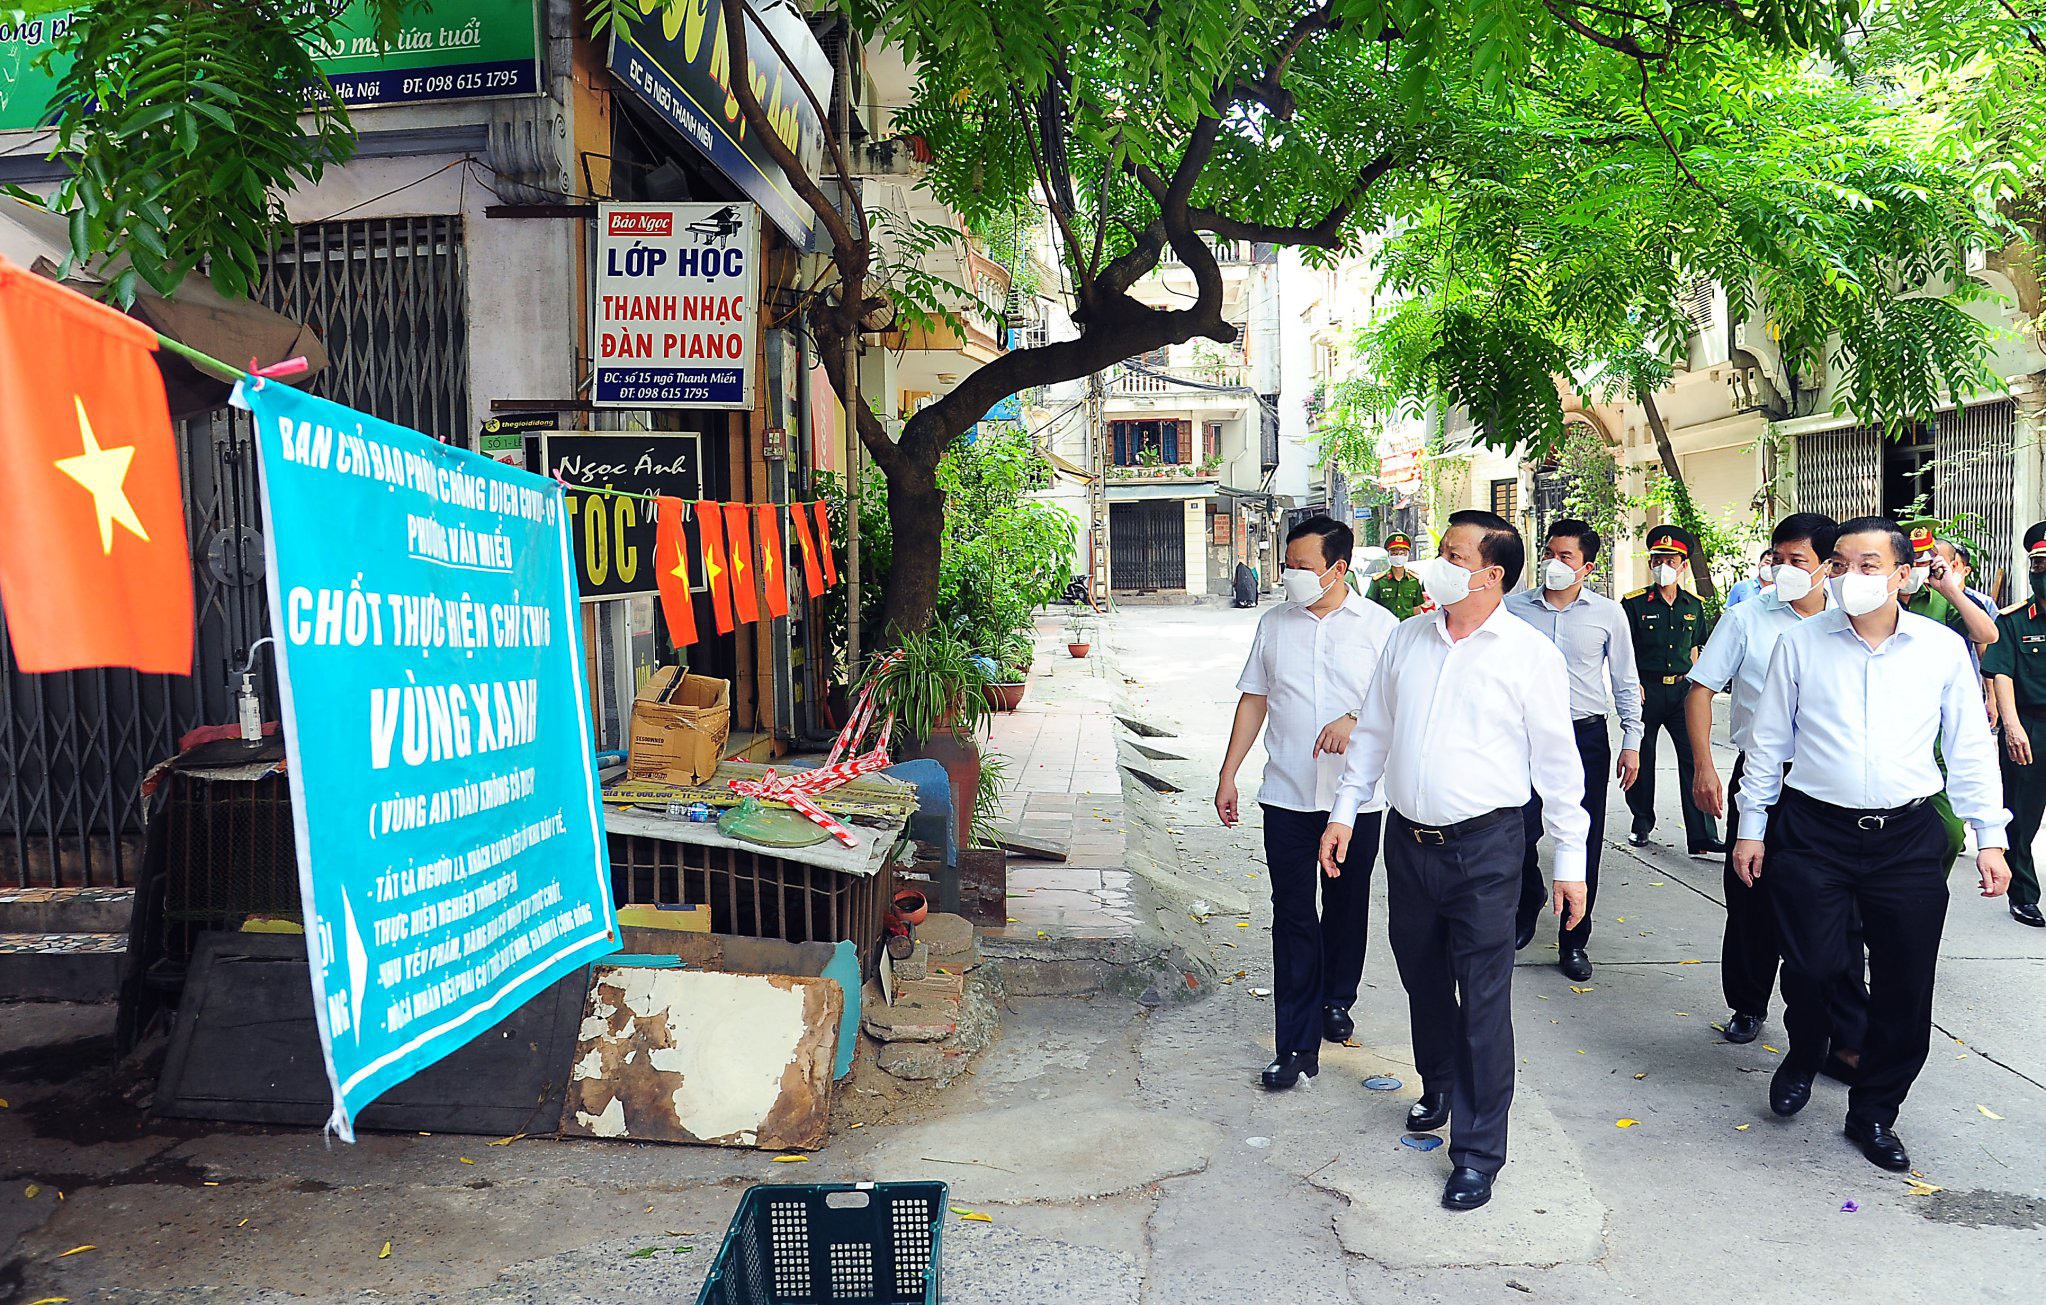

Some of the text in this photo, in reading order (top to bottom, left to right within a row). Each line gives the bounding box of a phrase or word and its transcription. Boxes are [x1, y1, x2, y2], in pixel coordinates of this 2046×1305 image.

[397, 27, 433, 50] lứa
[439, 16, 481, 47] tuổi
[335, 81, 354, 99] Hà
[357, 81, 380, 100] Nội
[402, 78, 423, 94] ĐT:
[426, 75, 453, 92] 098
[456, 72, 482, 90] 615
[486, 69, 519, 88] 1795
[643, 72, 654, 95] 15
[671, 97, 697, 136] THANH
[638, 215, 670, 232] Ngọc
[607, 240, 743, 283] LỚP HỌC
[602, 295, 743, 326] THANH NHẠC
[601, 327, 743, 359] ĐÀN PIANO
[604, 371, 737, 385] ĐC: số 15 ngõ Thanh Miến
[619, 388, 709, 399] ĐT: 098 615 1795
[488, 437, 501, 448] SỐ
[501, 420, 554, 429] thegioididong
[278, 416, 333, 470] BAN
[335, 423, 371, 478] CHỈ
[404, 448, 439, 502] PHÒN
[437, 461, 486, 512] CHỐNG
[489, 478, 519, 521] DỊCH
[559, 447, 686, 483] Ngọc Ánh
[447, 521, 478, 565] VĂN
[476, 523, 513, 568] MIẾU
[288, 571, 383, 647] CHỐT
[387, 591, 446, 659] THỰC
[445, 591, 489, 659] HIỆN
[490, 588, 520, 648] CHỈ
[370, 668, 537, 770] VÙNG XANH
[428, 789, 451, 826] AN
[450, 778, 480, 820] TOÀN
[375, 864, 400, 903] TẤT
[401, 857, 417, 897] CẢ
[416, 853, 452, 892] NGƯỜI
[373, 911, 409, 948] THỰC
[411, 901, 438, 938] HIỆN
[404, 942, 429, 980] YẾU
